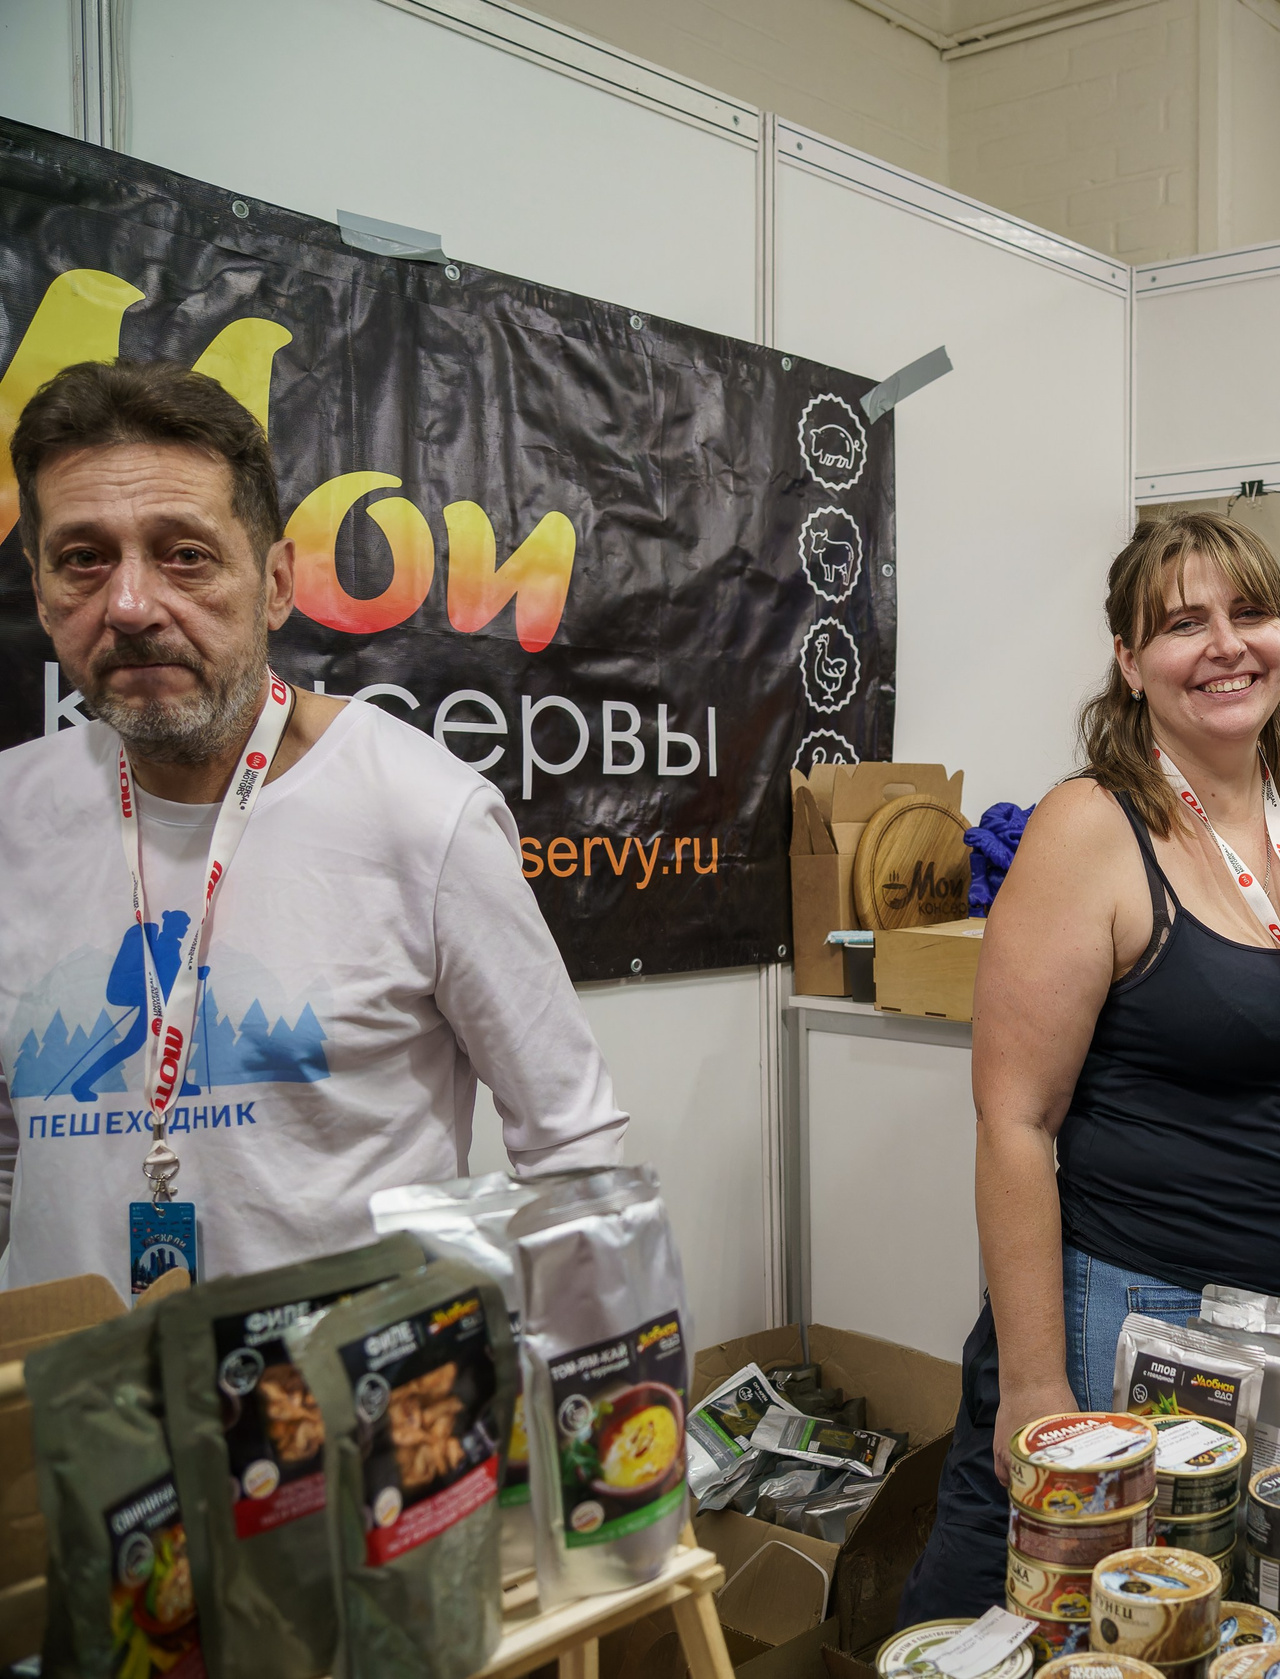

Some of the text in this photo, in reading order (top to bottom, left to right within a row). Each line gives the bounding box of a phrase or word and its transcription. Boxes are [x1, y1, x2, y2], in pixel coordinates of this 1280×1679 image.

[236, 768, 251, 796] MOTORS
[239, 771, 259, 806] UNIVERSAL
[1151, 1361, 1177, 1377] ПЛОВ
[1196, 1373, 1235, 1393] Удобная
[1214, 1389, 1233, 1401] еда
[1037, 1419, 1101, 1442] КИЛЬКА
